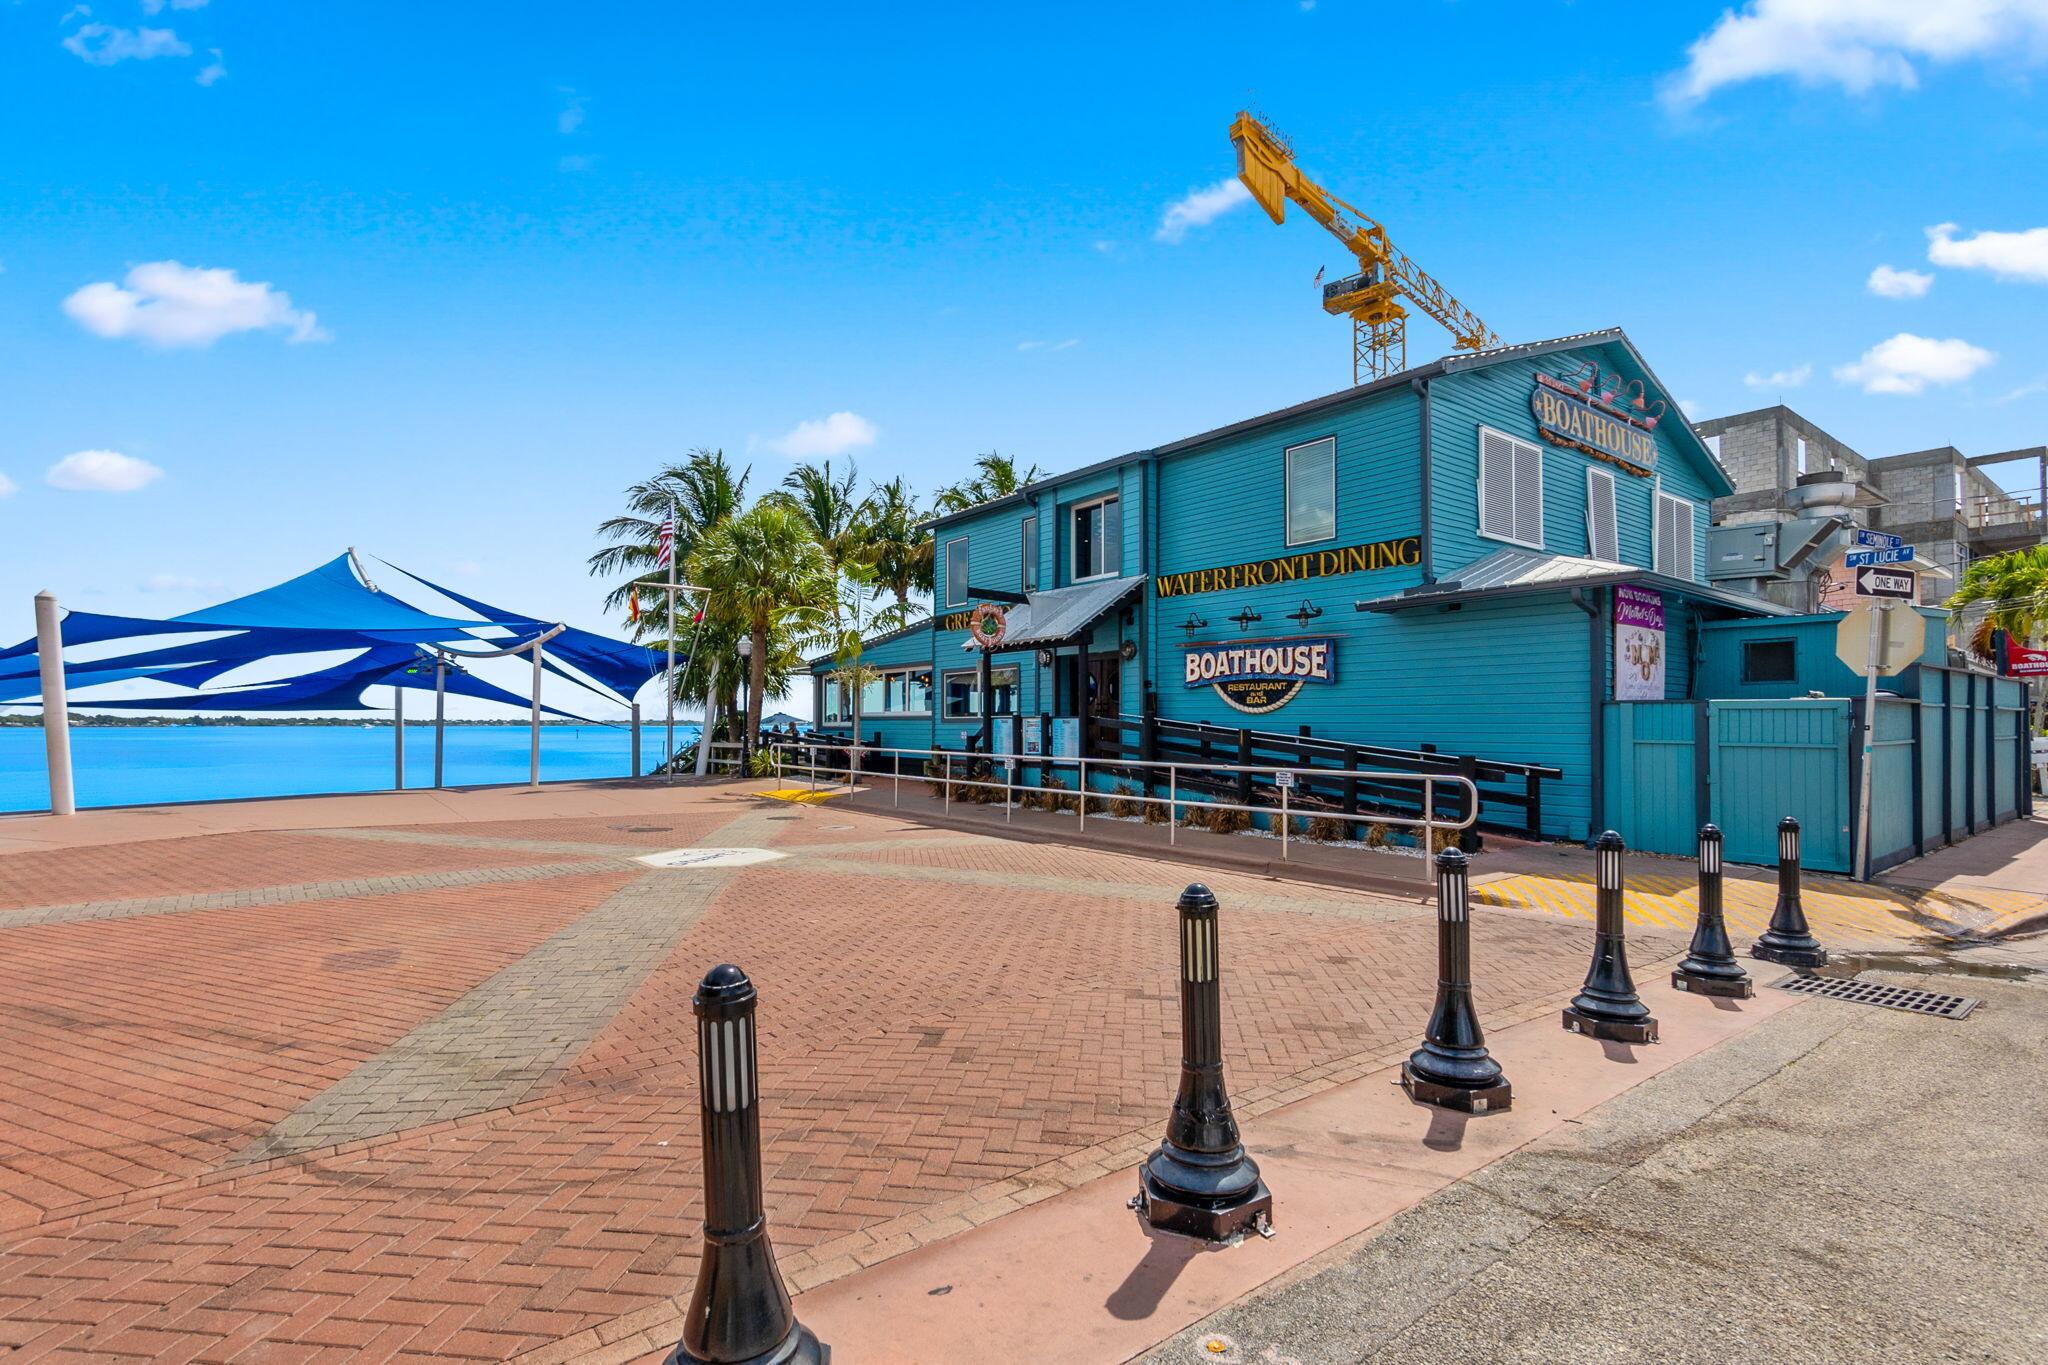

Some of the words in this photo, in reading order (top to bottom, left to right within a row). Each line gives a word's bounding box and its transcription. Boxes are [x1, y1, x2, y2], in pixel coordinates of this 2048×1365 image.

[1542, 391, 1653, 465] BOATHOUSE
[1866, 533, 1894, 548] SEMINOLE
[1860, 553, 1870, 565] ST
[1874, 550, 1899, 563] LUCIE
[1157, 554, 1315, 598] WATERFRONT
[1319, 538, 1421, 578] DINING
[1875, 577, 1891, 588] ONE
[1894, 578, 1909, 590] WAY
[1618, 588, 1634, 600] NOW
[1633, 591, 1661, 606] BOOKING
[1185, 644, 1328, 683] BOATHOUSE
[1228, 682, 1288, 692] RESTAURANT
[1246, 696, 1267, 704] BAR
